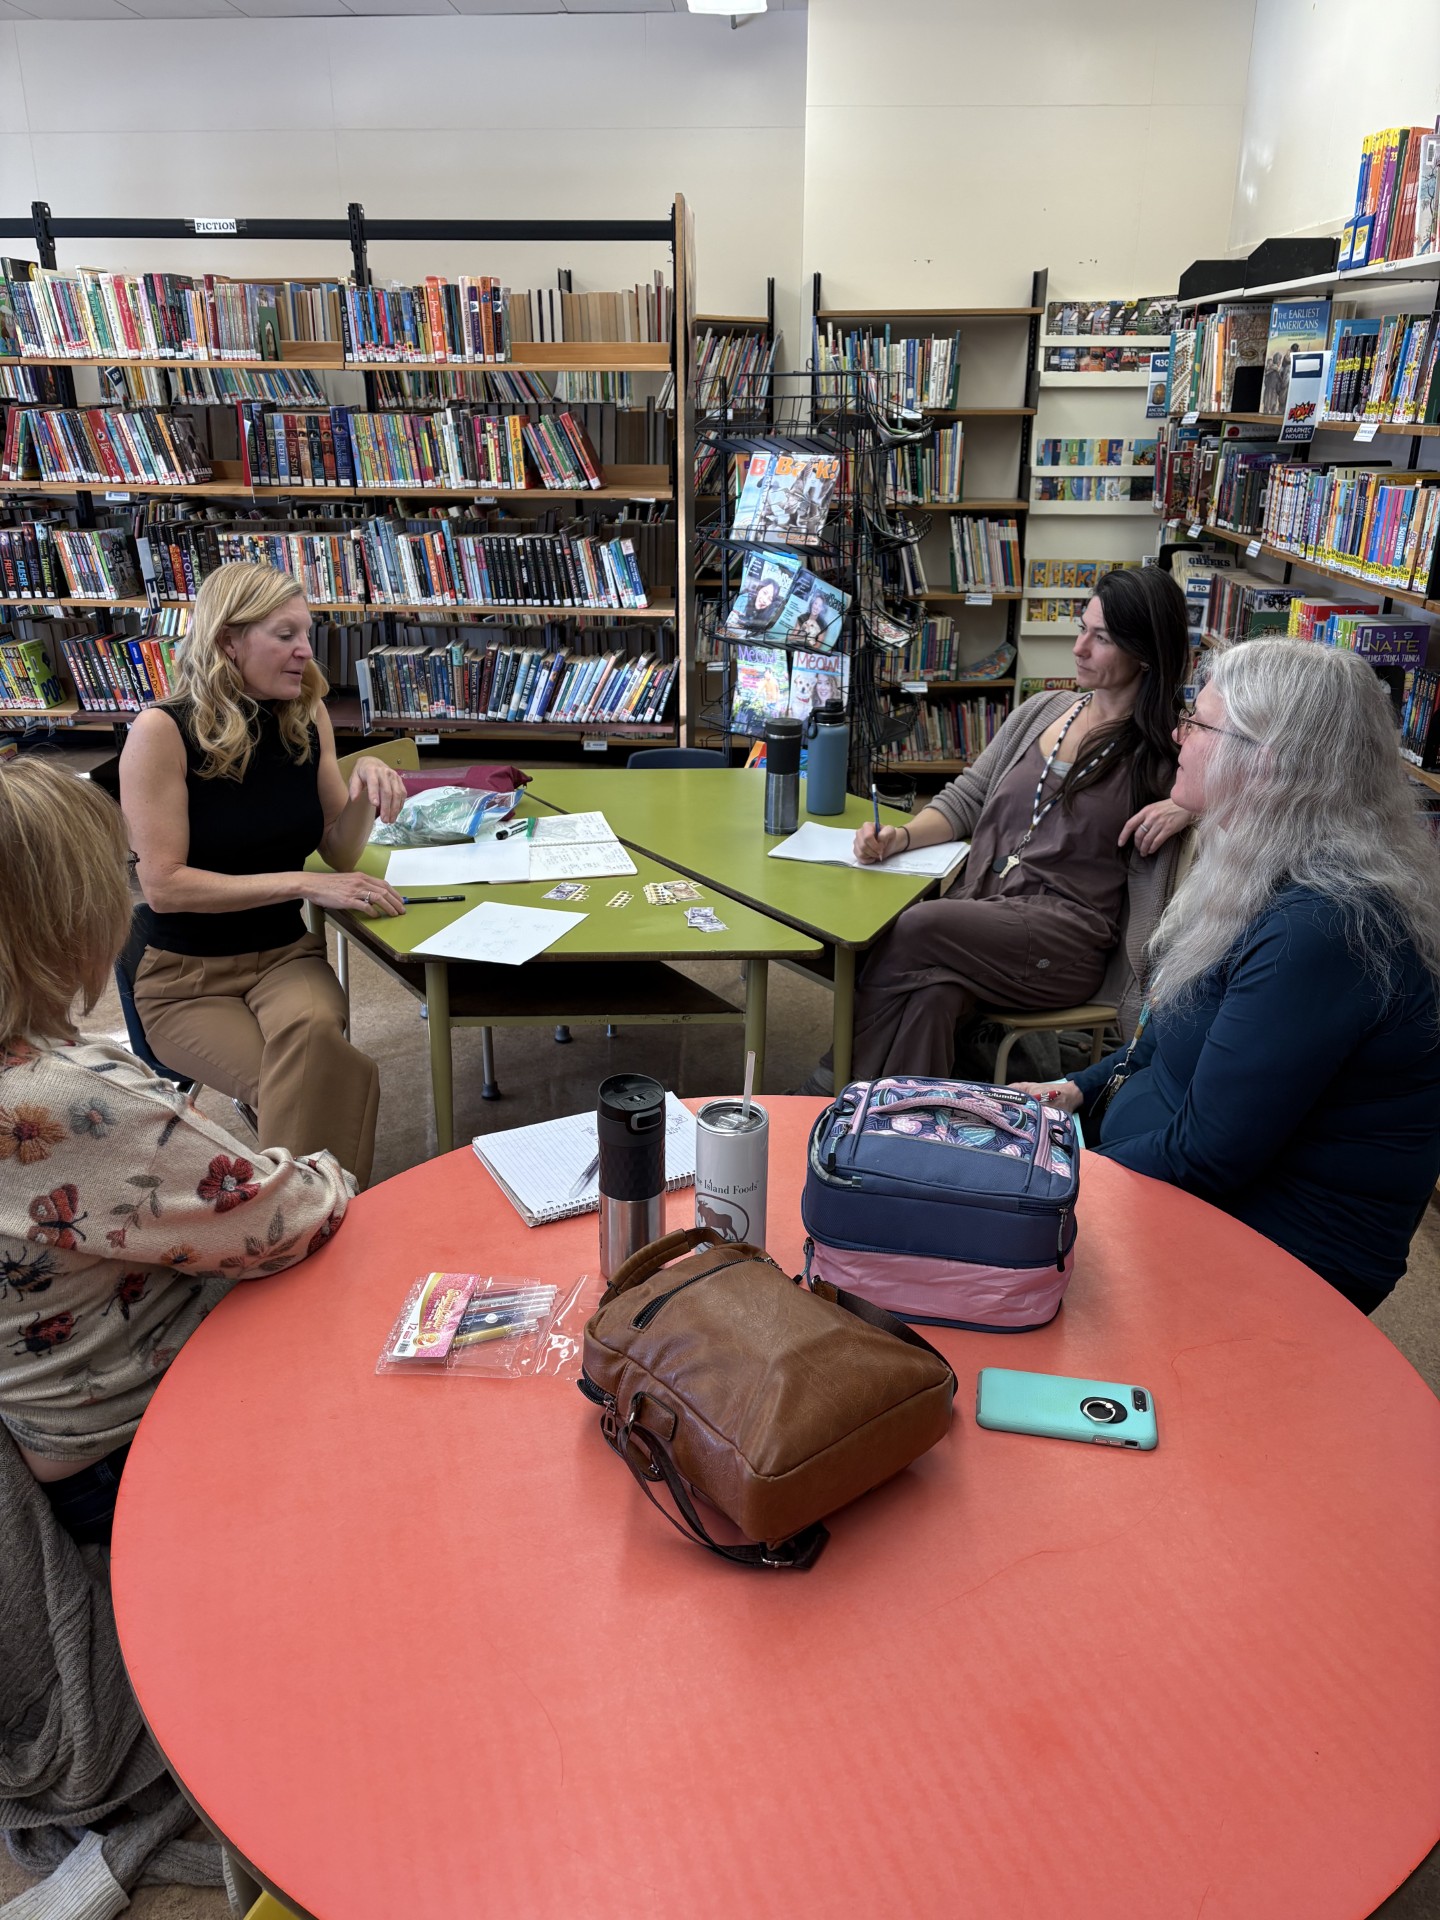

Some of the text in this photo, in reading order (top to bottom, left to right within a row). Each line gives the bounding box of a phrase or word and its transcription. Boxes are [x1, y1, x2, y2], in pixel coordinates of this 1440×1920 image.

[196, 221, 235, 232] FICTION
[1278, 320, 1318, 329] AMERICANS
[1289, 308, 1320, 319] EARLIEST
[1289, 403, 1316, 420] POW!
[133, 453, 144, 471] MOONS
[277, 440, 285, 465] ICEFIRE
[776, 456, 840, 479] Bark!
[2, 558, 16, 587] FREEFALL
[15, 559, 28, 586] CLOSER
[28, 557, 41, 584] SPIRAL
[40, 556, 53, 586] TERMINAL
[149, 546, 167, 592] FOUND
[170, 547, 186, 592] SABOTAGED
[180, 554, 195, 590] TORN
[332, 560, 342, 578] WINK
[565, 554, 574, 578] RAVEN'S
[1188, 557, 1231, 567] GREEKS
[1367, 640, 1420, 653] NATE
[68, 656, 83, 689] SWINDLE
[84, 659, 97, 687] FRAMED
[93, 656, 107, 688] SHOWOFF
[101, 656, 116, 687] HIDEOUT
[109, 657, 123, 687] JACKPOT
[144, 653, 155, 680] OPERATION
[796, 652, 840, 672] Meow!
[40, 676, 63, 705] POP
[134, 662, 150, 692] NOTORIOUS
[524, 668, 533, 688] WRINKLE
[704, 1180, 729, 1194] Island
[733, 1183, 758, 1195] Foods
